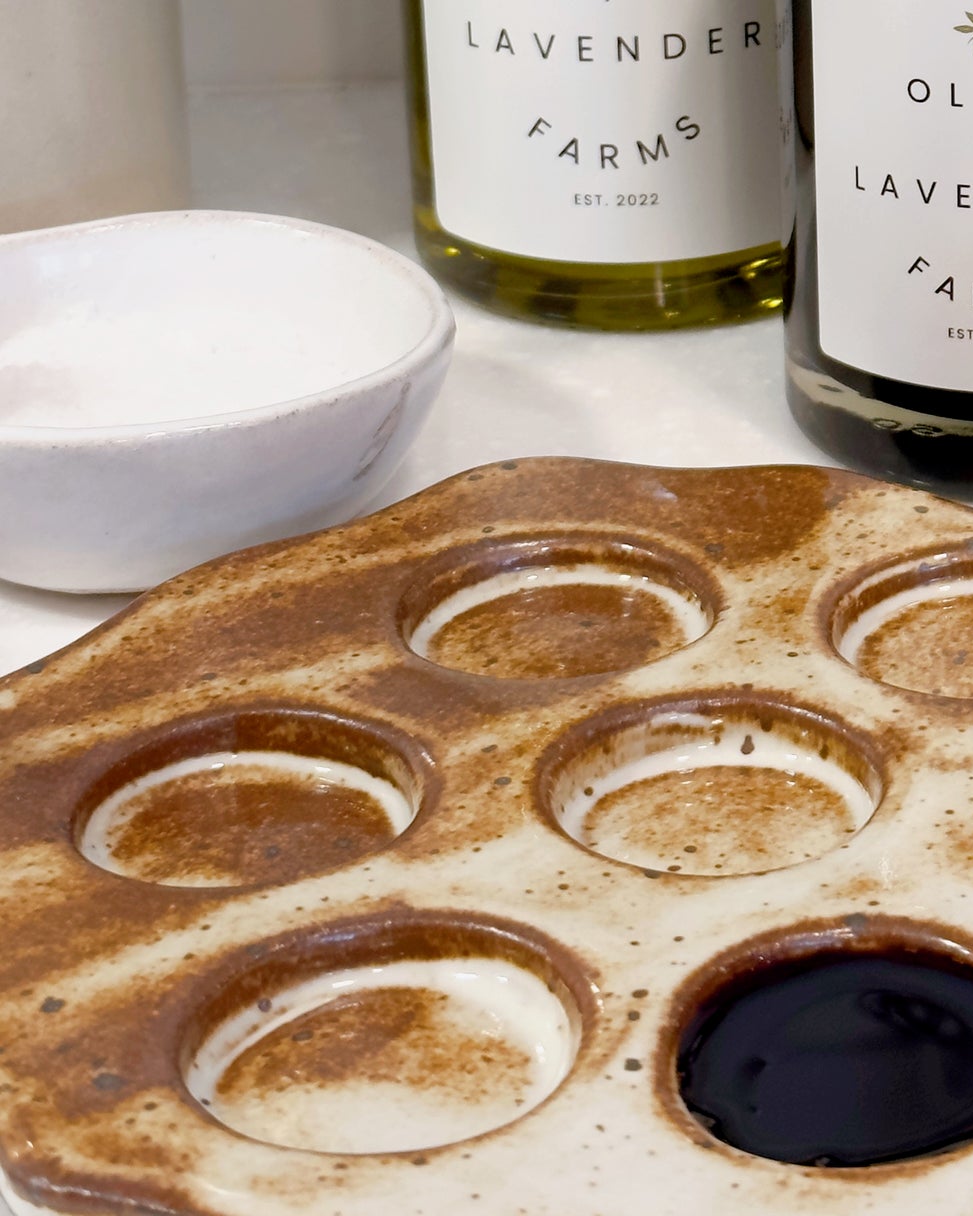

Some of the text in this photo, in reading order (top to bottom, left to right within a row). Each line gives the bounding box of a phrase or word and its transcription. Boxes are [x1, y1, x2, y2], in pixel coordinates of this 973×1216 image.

[467, 20, 761, 63] LAVENDER
[527, 115, 701, 170] FARMS
[573, 192, 659, 207] EST. 2022
